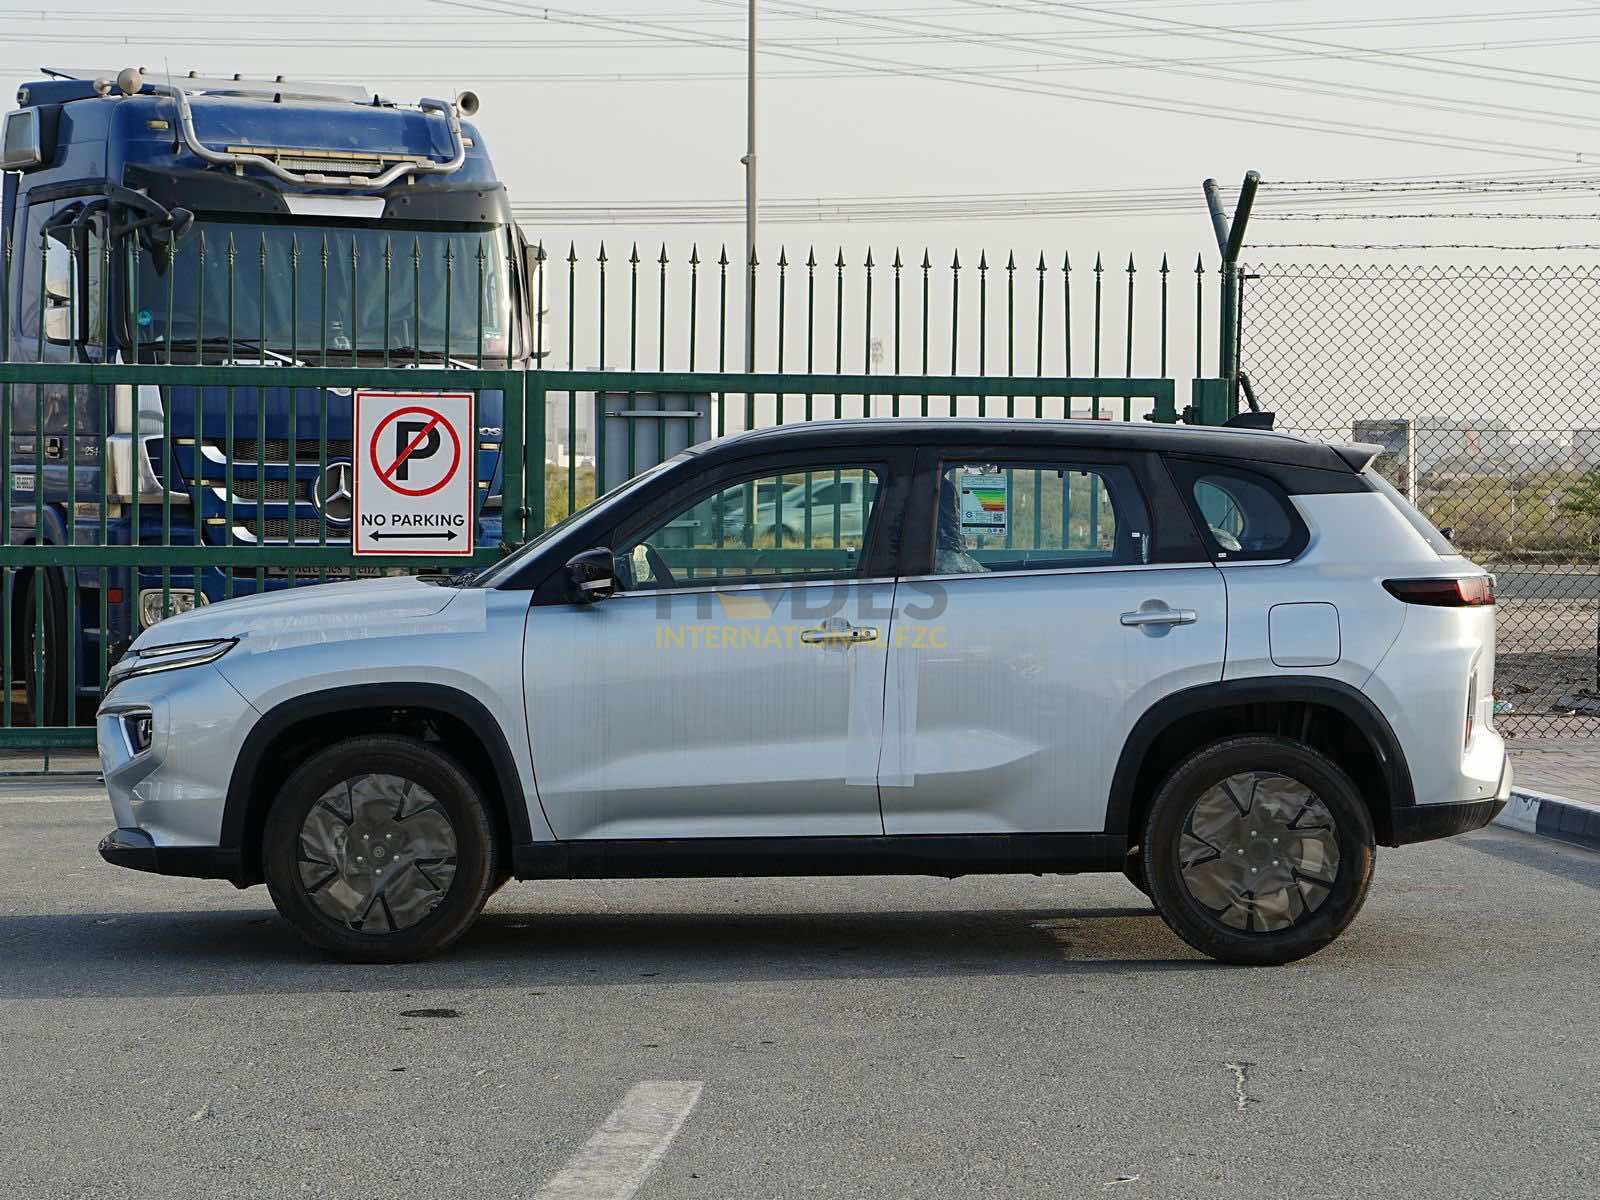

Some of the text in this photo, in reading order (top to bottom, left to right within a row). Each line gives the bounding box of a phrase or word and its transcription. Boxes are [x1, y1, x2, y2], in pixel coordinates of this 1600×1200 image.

[396, 421, 441, 481] P
[361, 513, 465, 527] NO PARKING
